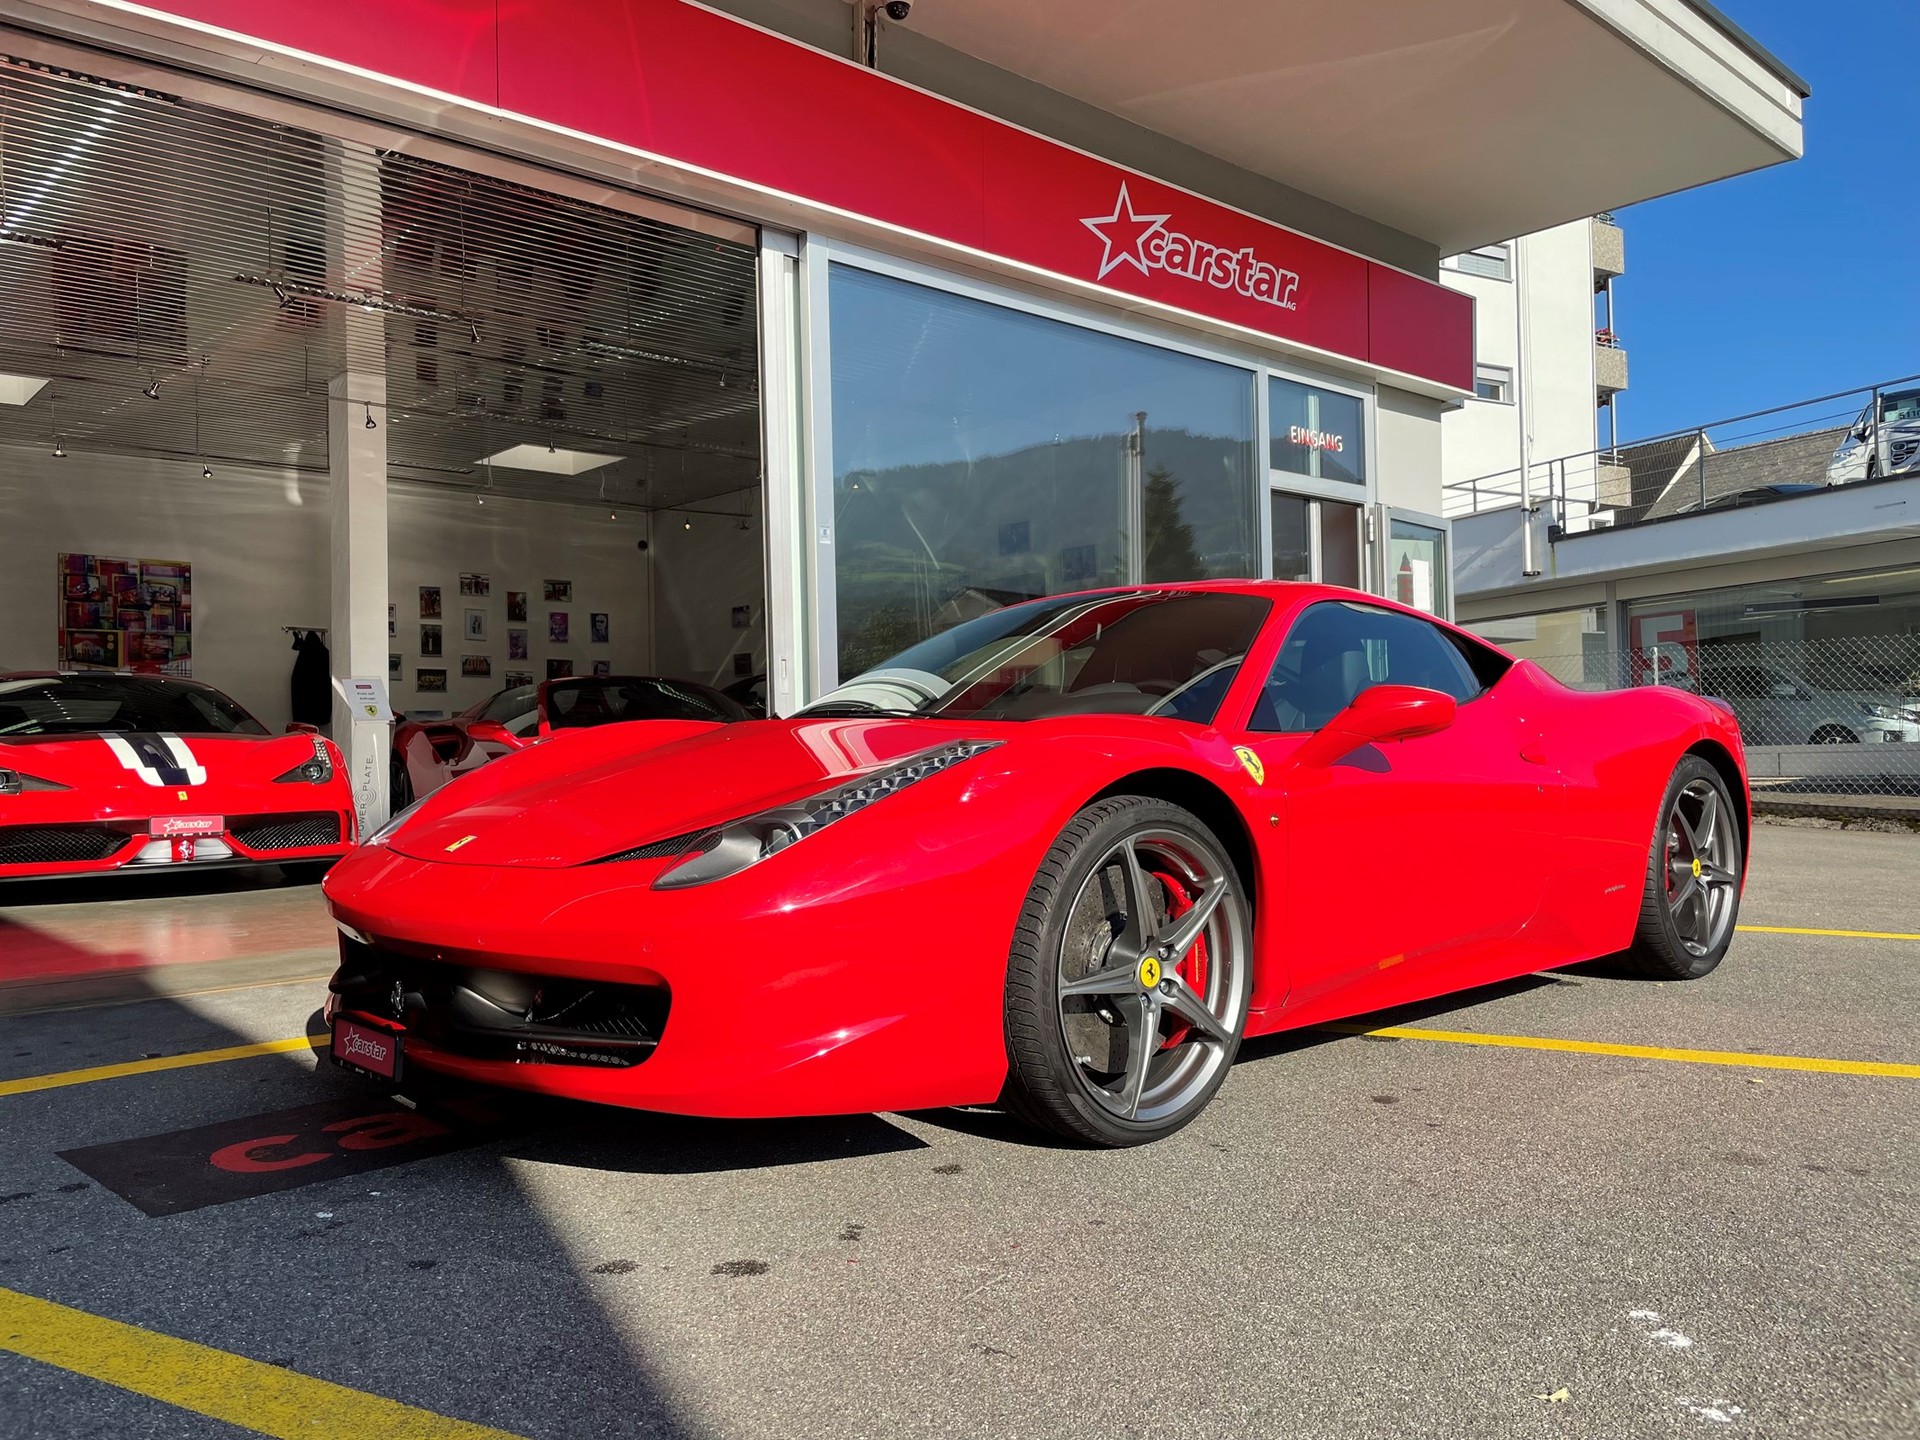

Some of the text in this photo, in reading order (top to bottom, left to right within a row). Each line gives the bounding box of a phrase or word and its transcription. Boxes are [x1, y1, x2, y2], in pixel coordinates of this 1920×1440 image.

[1141, 226, 1300, 311] carstar AG
[1290, 425, 1343, 452] EINGANG
[353, 1036, 387, 1061] carstar
